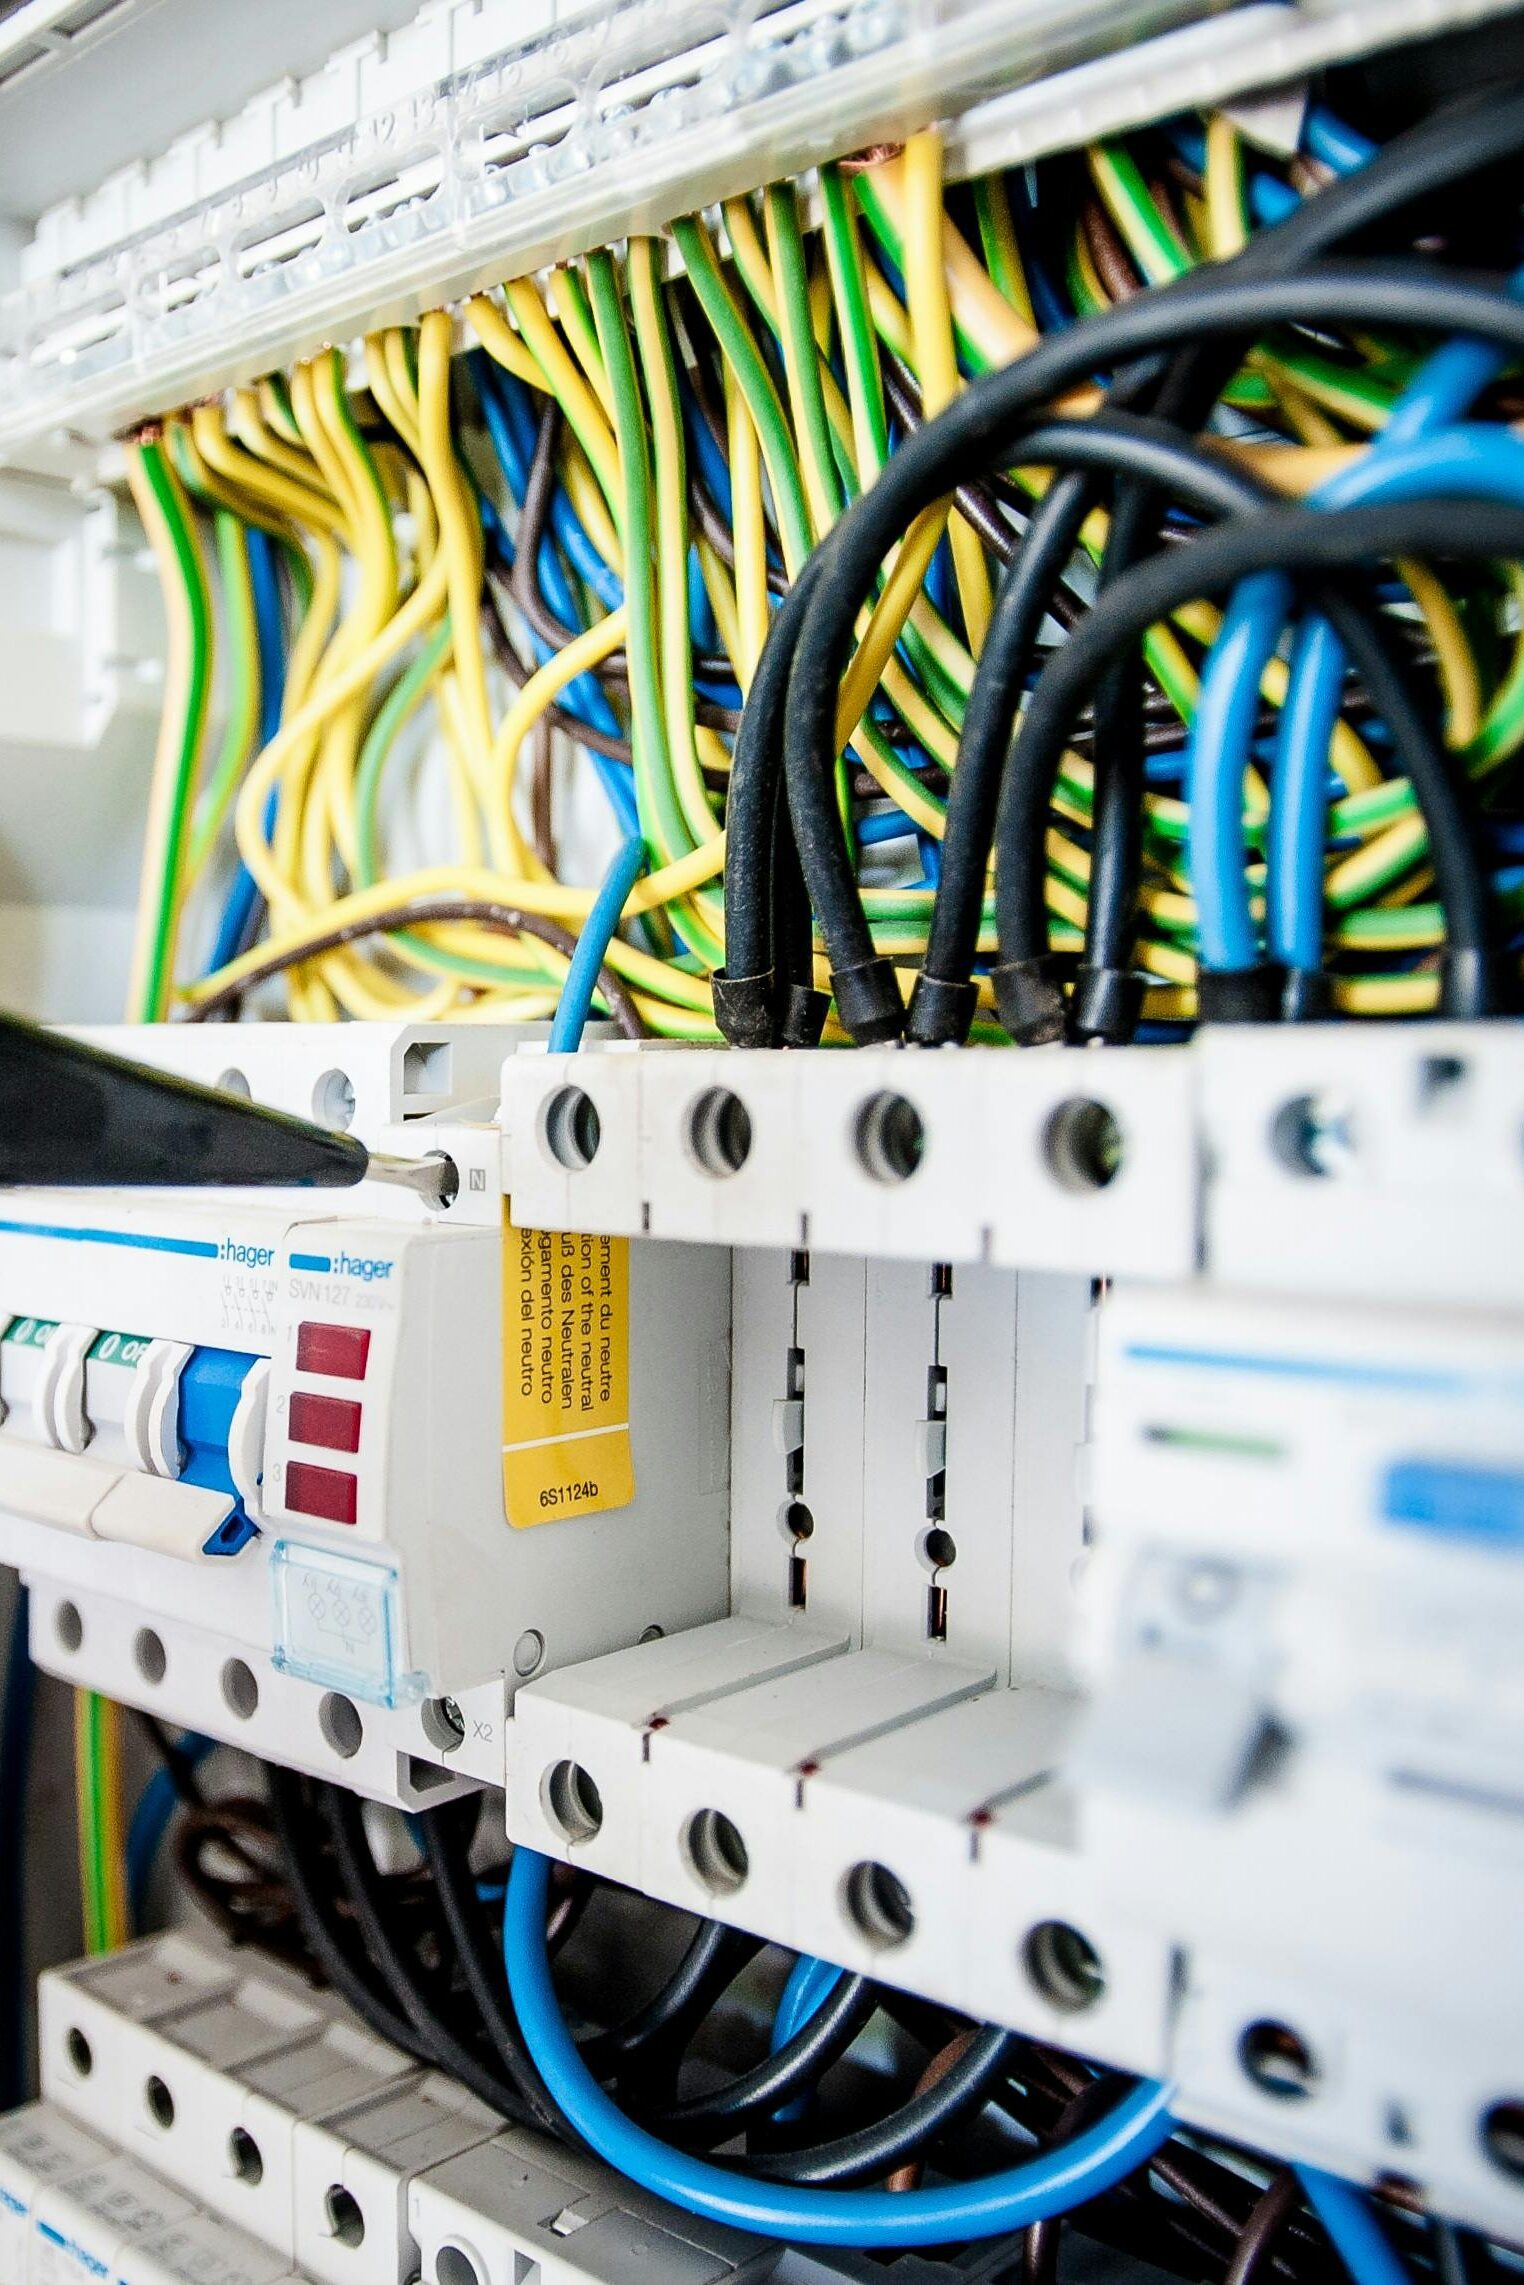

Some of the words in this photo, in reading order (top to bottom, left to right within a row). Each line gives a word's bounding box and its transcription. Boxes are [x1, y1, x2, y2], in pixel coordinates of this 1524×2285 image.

[470, 1168, 486, 1192] N
[289, 1278, 320, 1303] SVN
[325, 1284, 350, 1306] 127
[561, 1264, 575, 1304] des
[581, 1276, 594, 1297] of
[521, 1289, 535, 1321] del
[580, 1302, 594, 1336] the
[600, 1304, 613, 1331] du
[521, 1327, 535, 1397] neutro
[541, 1336, 554, 1405] neutro
[561, 1309, 575, 1410] Neutralen
[600, 1337, 613, 1402] neutre
[580, 1343, 594, 1412] neutral
[276, 1394, 286, 1414] 2
[272, 1463, 282, 1482] 3
[540, 1481, 599, 1508] 6S1124b
[473, 1720, 493, 1743] X2
